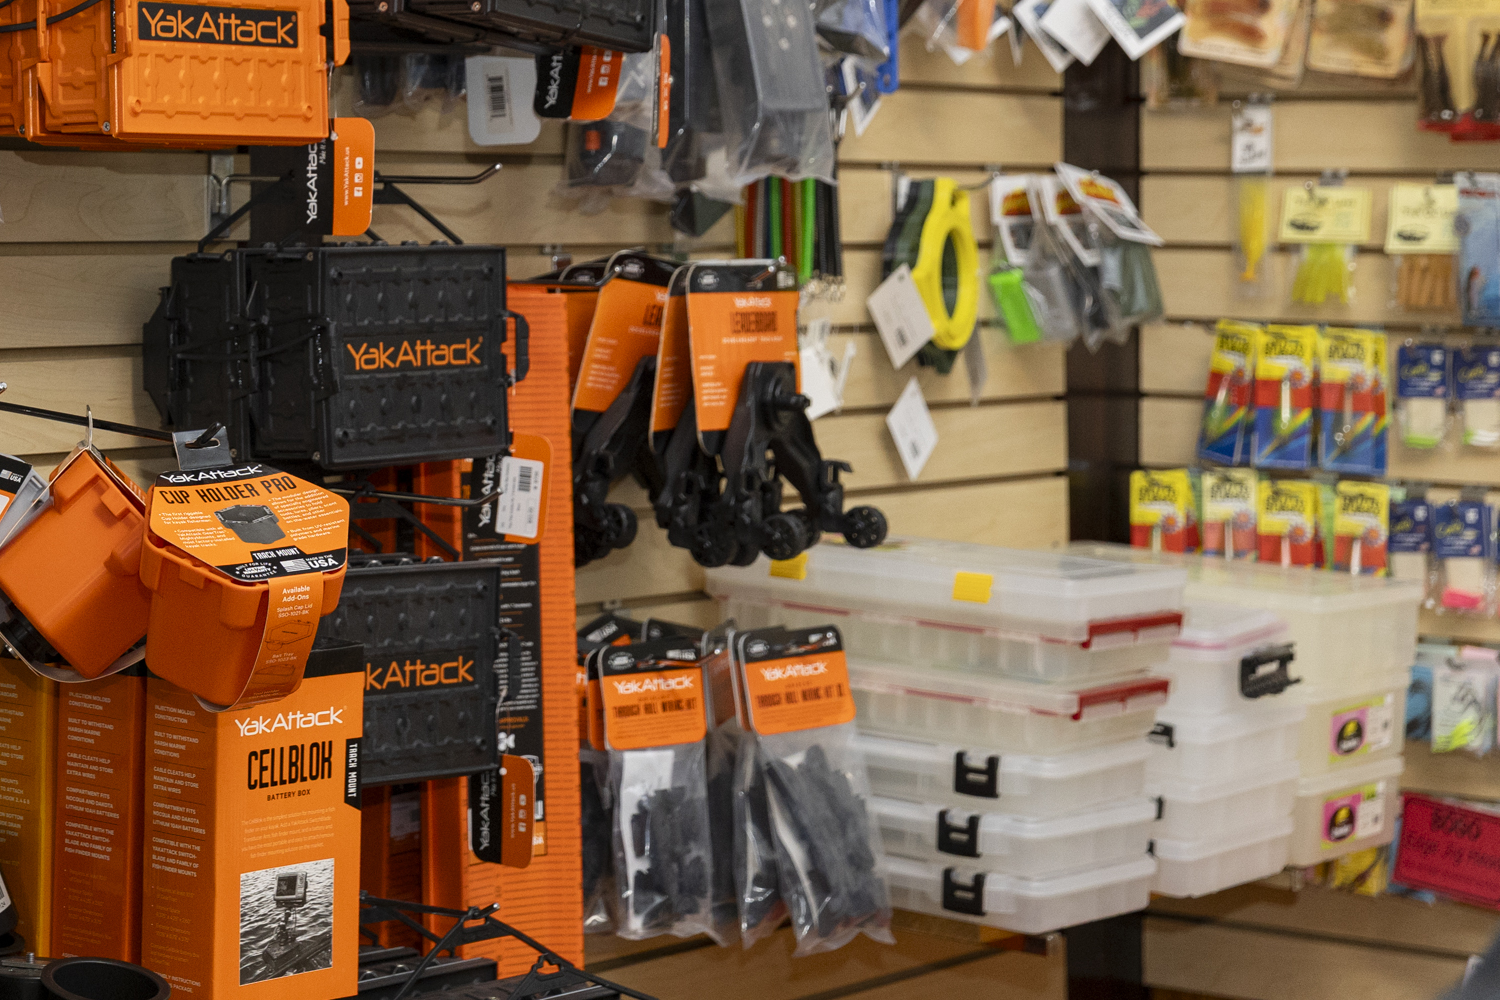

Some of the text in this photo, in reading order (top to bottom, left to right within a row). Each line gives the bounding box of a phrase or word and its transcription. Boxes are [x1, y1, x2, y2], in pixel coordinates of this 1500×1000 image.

[141, 6, 295, 44] YakAttack
[307, 143, 318, 224] YakAttac
[347, 338, 481, 370] YakAttack
[160, 464, 262, 484] YakAttack
[159, 475, 298, 505] CUP HOLDER PRO
[252, 547, 300, 560] TRACK MOUNT
[308, 559, 339, 569] USA
[282, 585, 311, 595] Available
[282, 594, 310, 603] Add-Ons
[366, 655, 474, 691] kAttack
[760, 660, 829, 682] YakAttack
[612, 675, 694, 695] YakAttack
[234, 706, 344, 737] YakAttack
[173, 734, 199, 744] WITHSTAND
[153, 749, 180, 758] CONDITIONS
[247, 740, 333, 791] CELLBLOK
[348, 743, 358, 798] TRACK MOUNT
[266, 788, 311, 802] BATTERY BOX
